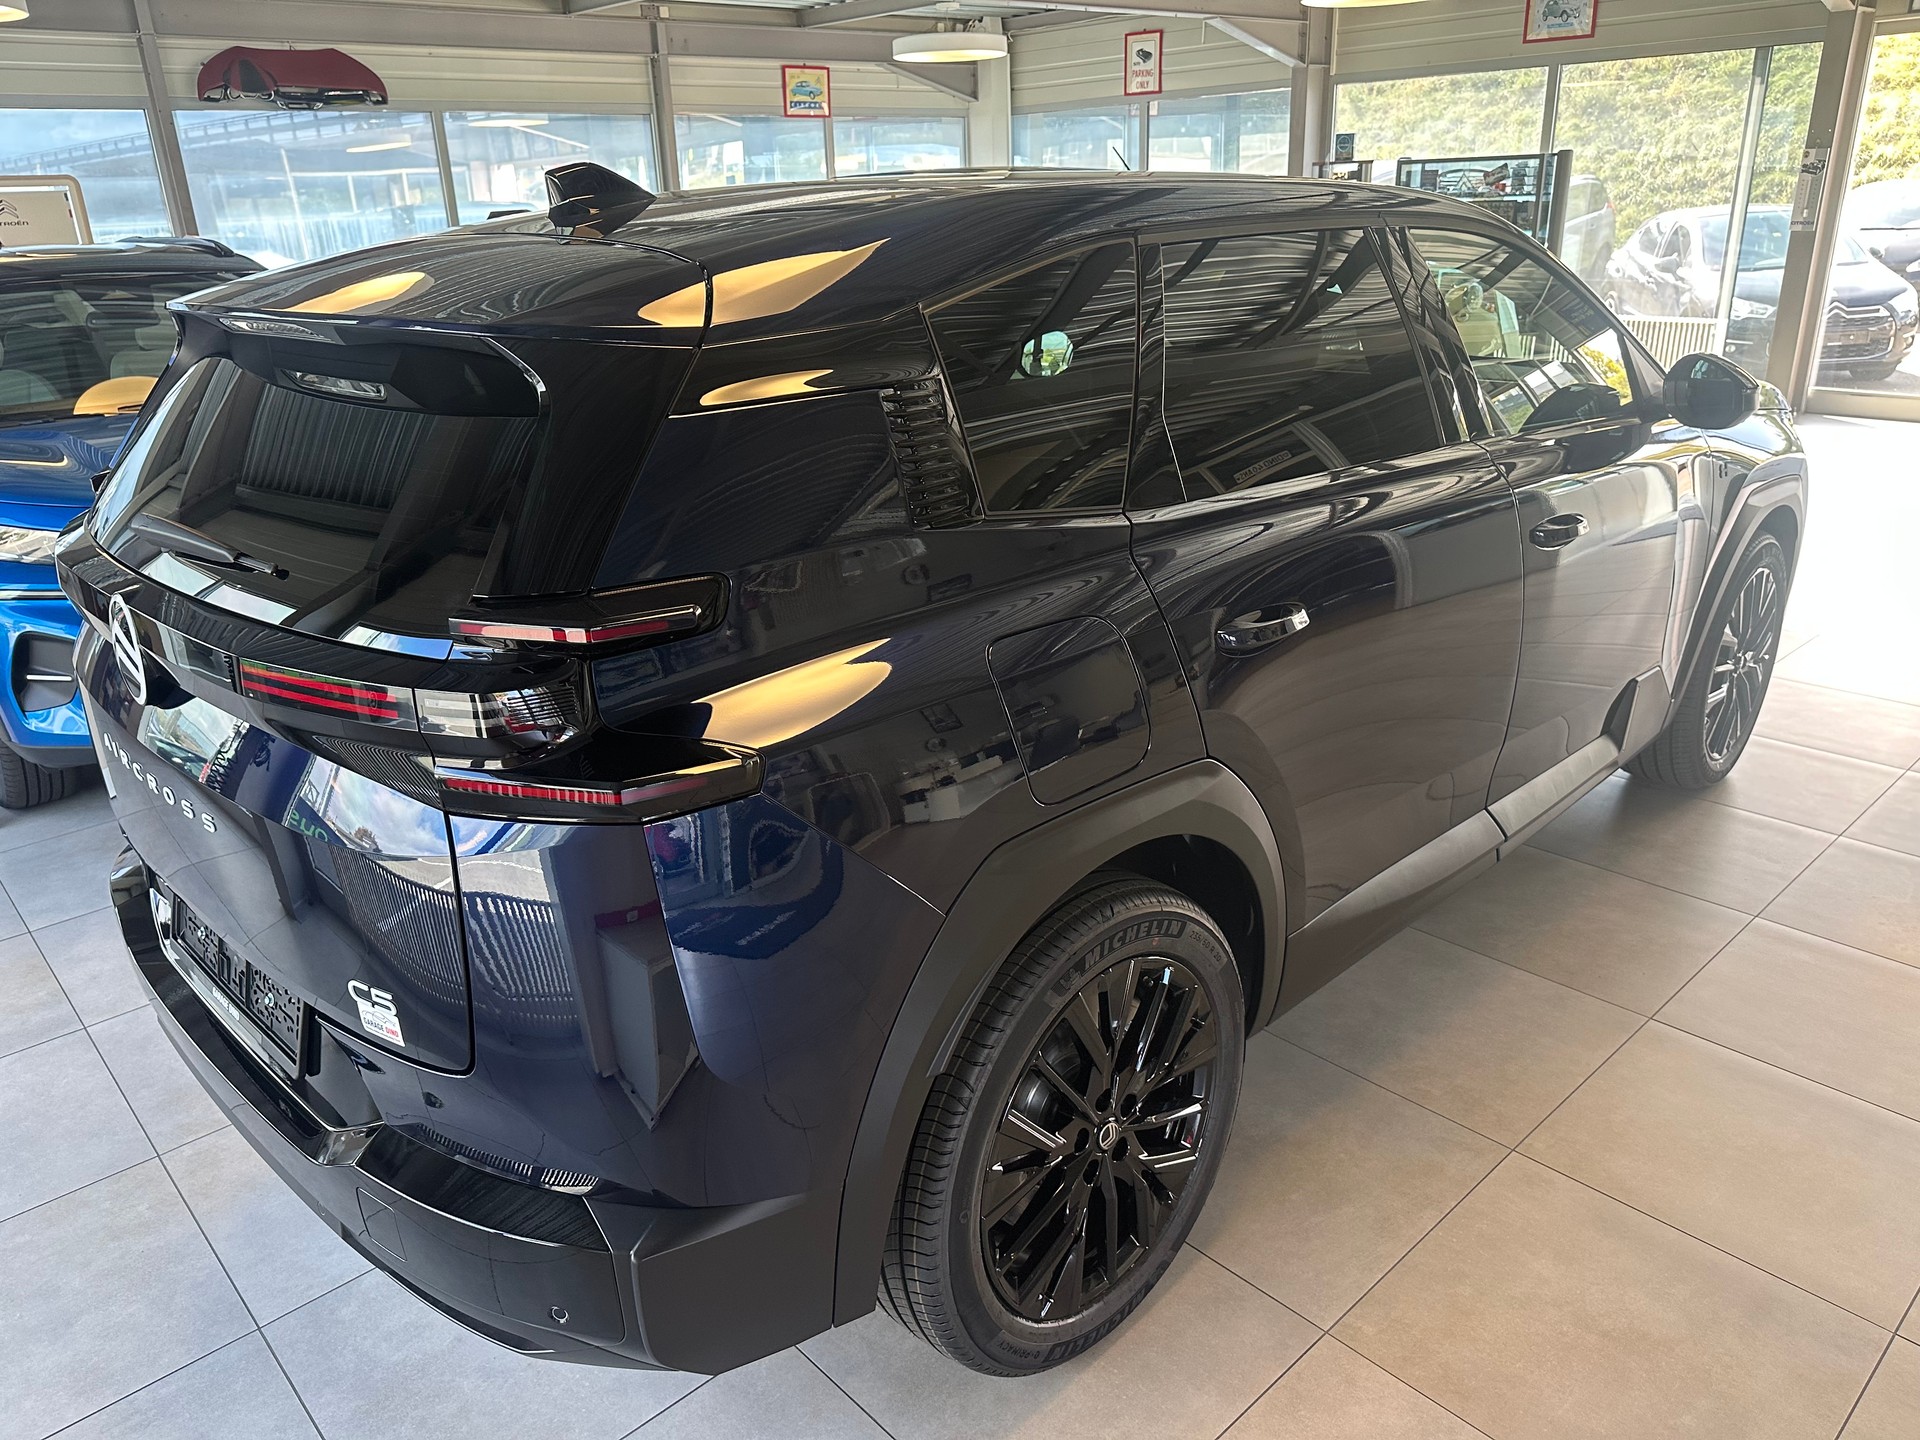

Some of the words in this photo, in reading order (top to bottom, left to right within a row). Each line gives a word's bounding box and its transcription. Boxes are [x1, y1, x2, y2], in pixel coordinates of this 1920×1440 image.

[1132, 69, 1154, 78] PARKING
[1135, 80, 1150, 90] ONLY
[104, 733, 218, 833] AIRCROSS
[1084, 920, 1183, 971] MICHELIN
[347, 979, 398, 1016] C5
[363, 1016, 385, 1032] GARAGE
[384, 1026, 399, 1038] DINO
